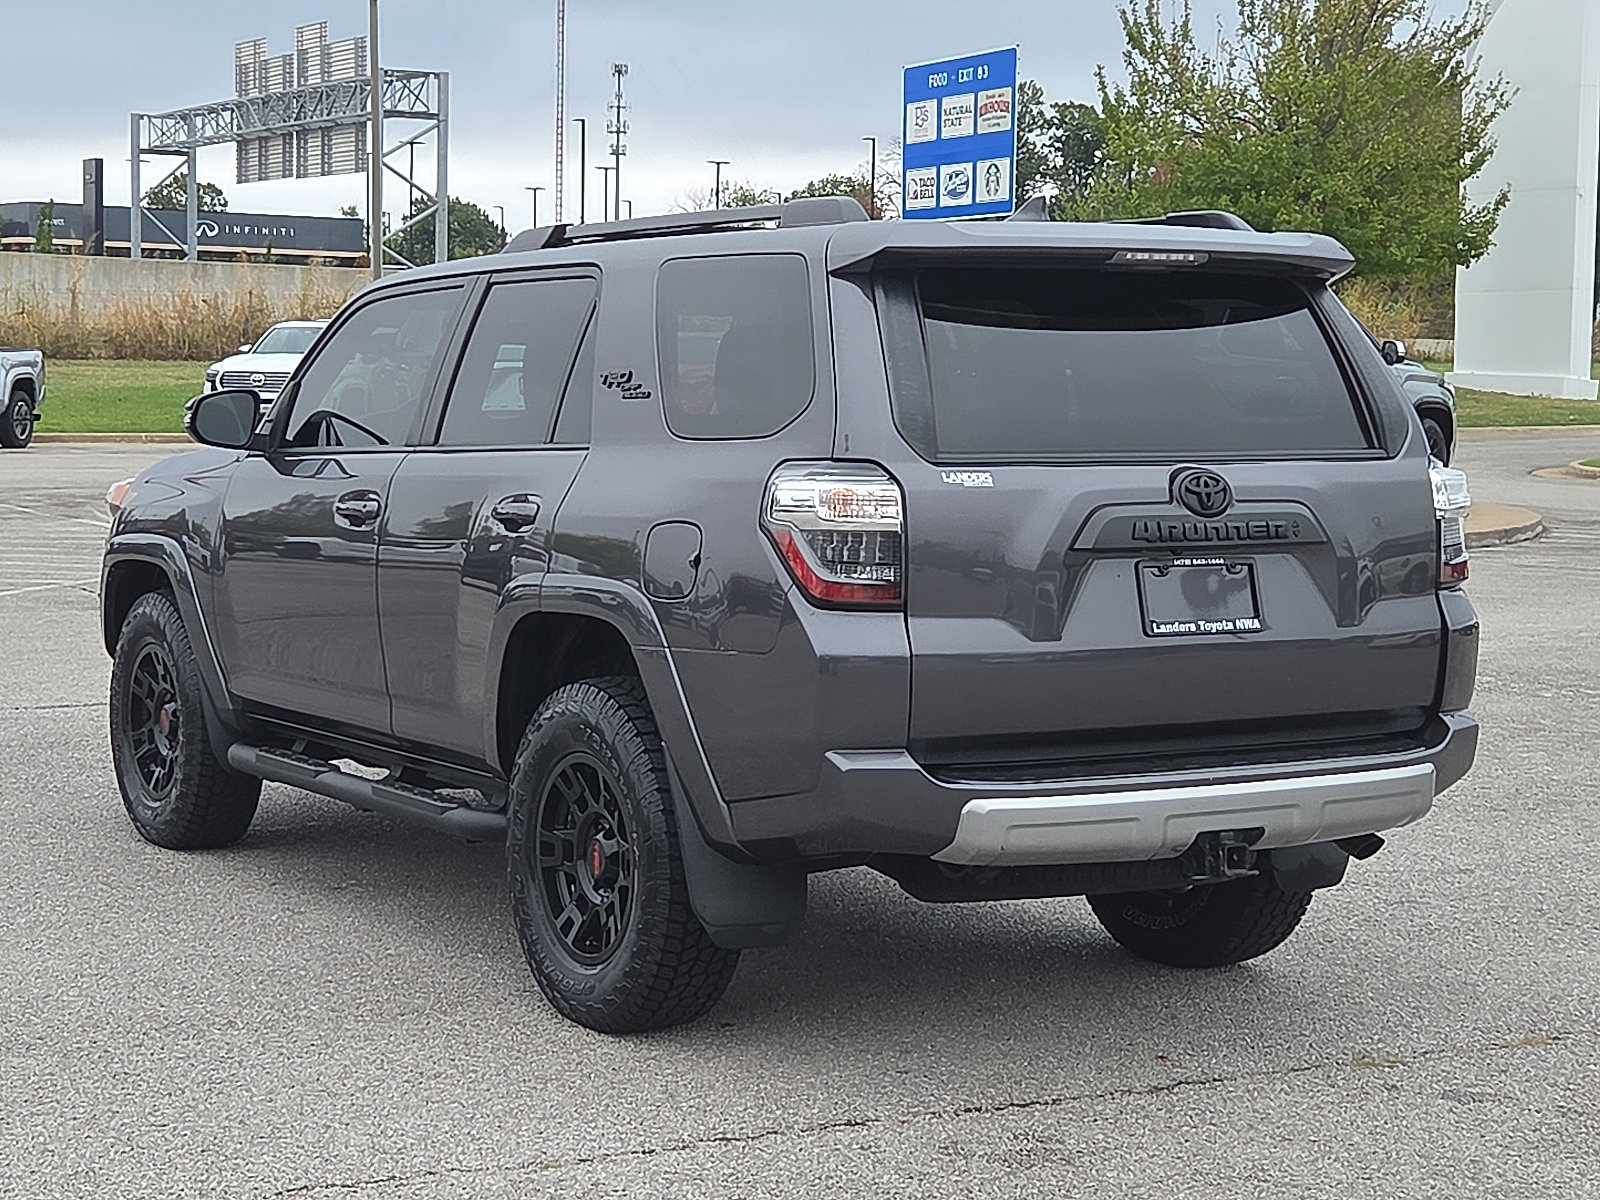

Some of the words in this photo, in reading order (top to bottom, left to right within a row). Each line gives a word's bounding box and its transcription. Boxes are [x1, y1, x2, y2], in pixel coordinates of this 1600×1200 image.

[928, 72, 948, 89] FOOD
[958, 67, 974, 83] EXIT
[977, 64, 988, 80] 83
[943, 104, 973, 117] NATURAL
[943, 116, 963, 128] STATE
[918, 176, 936, 188] TACO
[919, 188, 935, 200] BELL
[225, 224, 295, 237] INFINITI
[940, 471, 993, 484] LANDERS
[1152, 621, 1197, 633] Landers
[1197, 620, 1234, 633] Toyota
[1235, 618, 1262, 630] NWA
